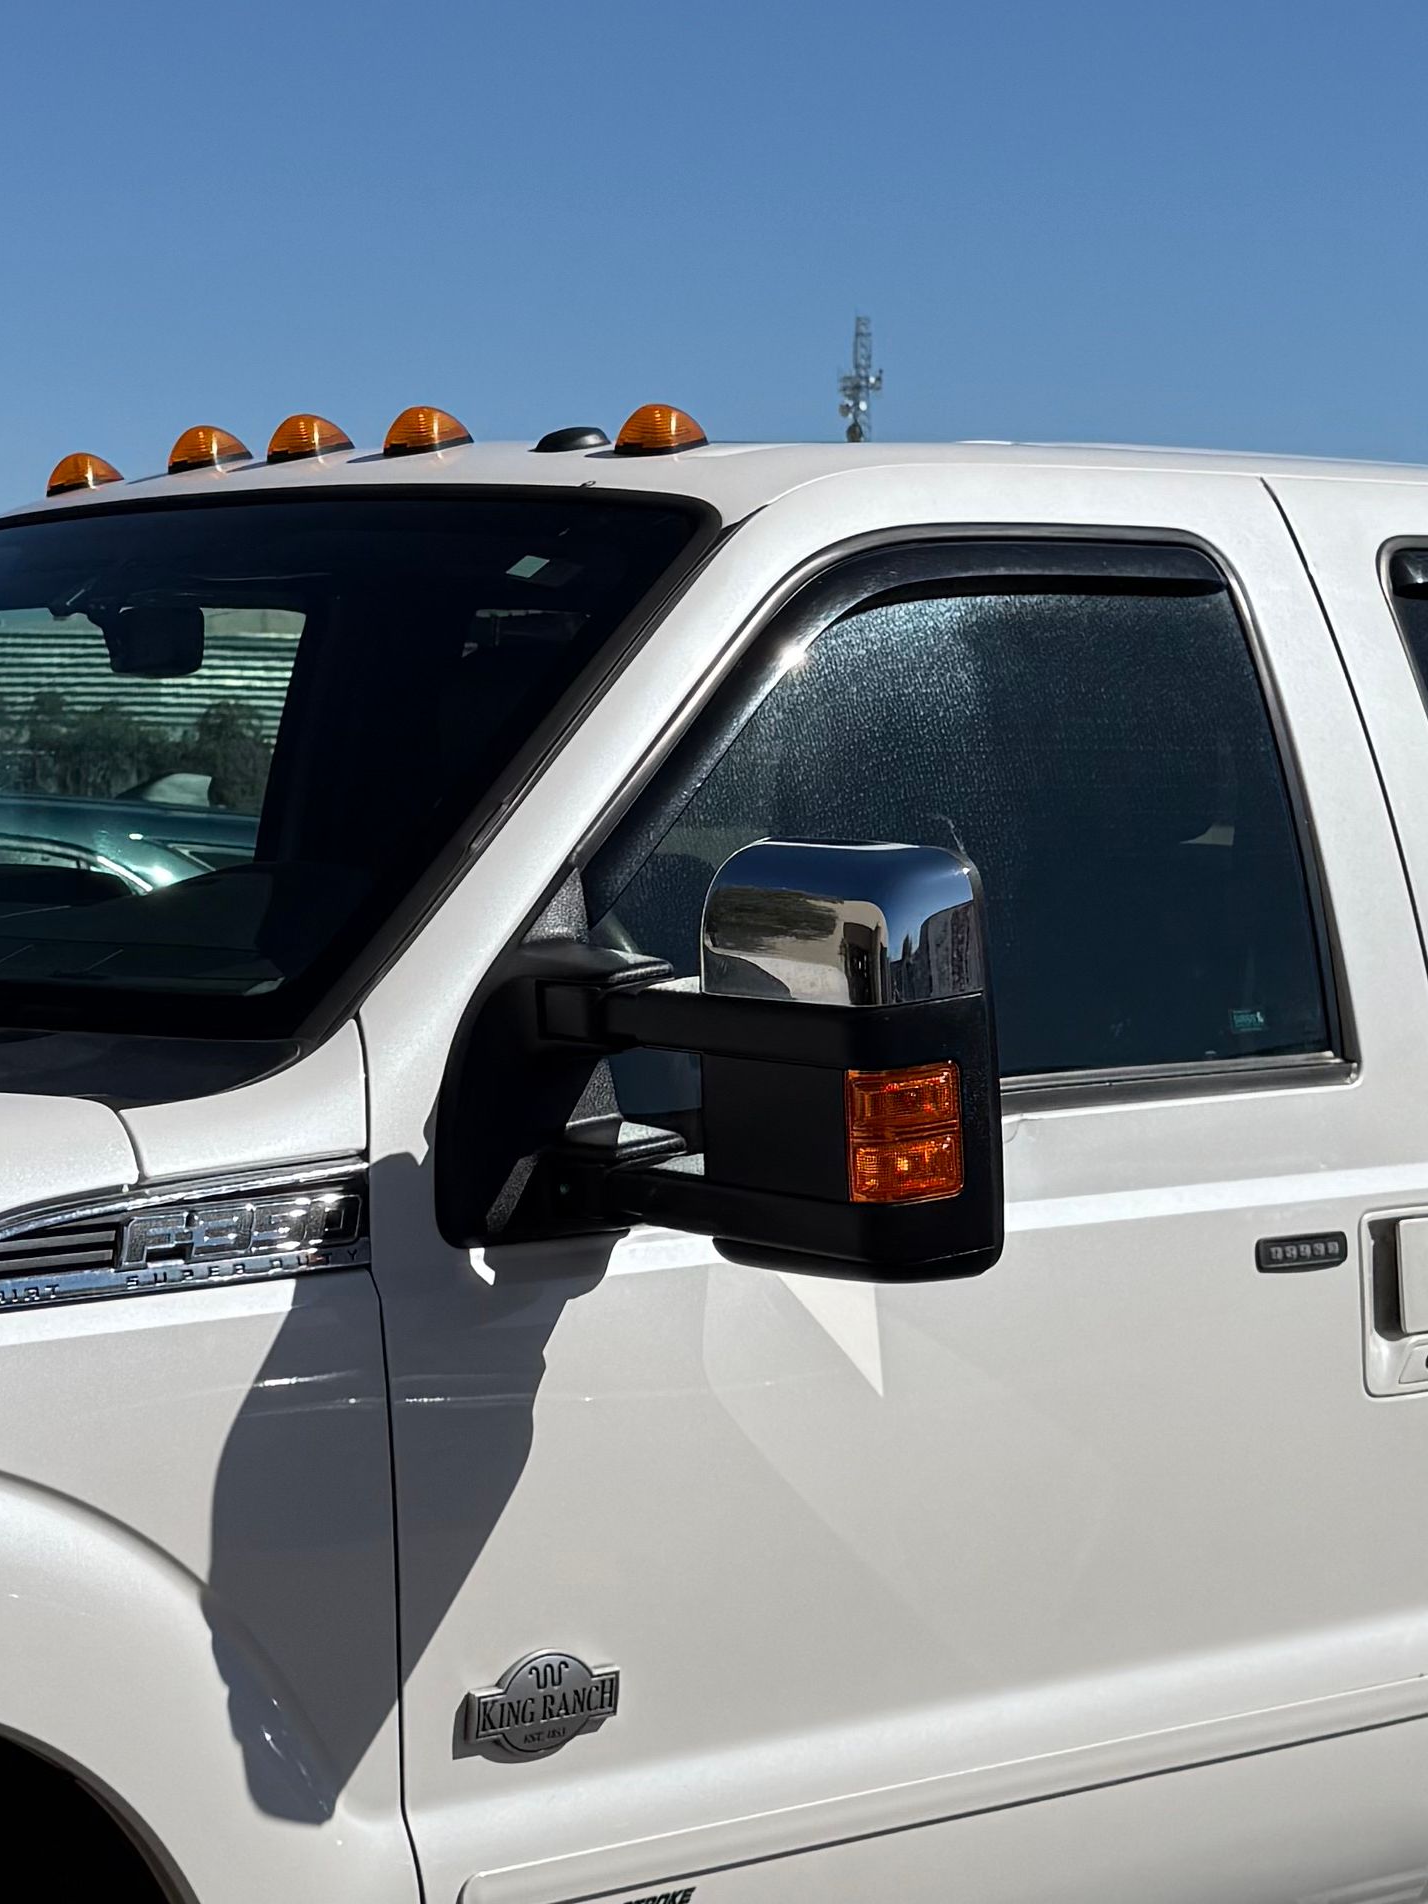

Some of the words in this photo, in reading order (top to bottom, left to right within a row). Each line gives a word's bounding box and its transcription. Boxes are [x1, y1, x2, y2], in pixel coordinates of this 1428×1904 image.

[126, 1263, 246, 1290] SUPER
[270, 1249, 359, 1270] DUTY
[480, 1697, 535, 1732] KING
[541, 1678, 615, 1721] RANCH
